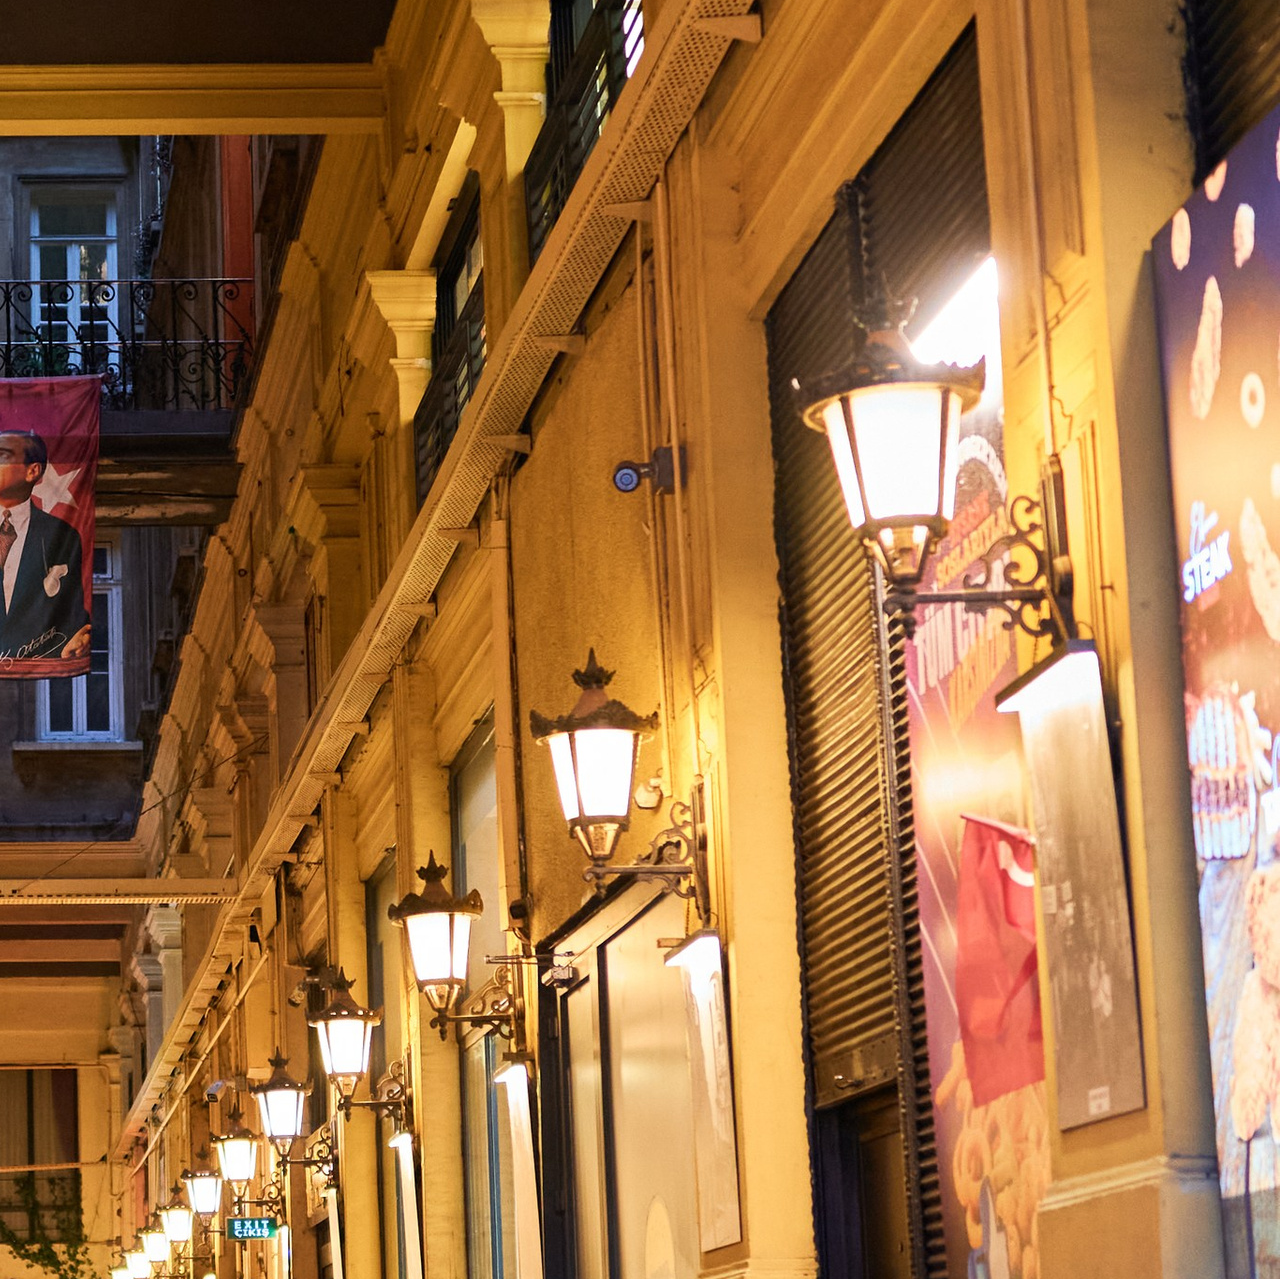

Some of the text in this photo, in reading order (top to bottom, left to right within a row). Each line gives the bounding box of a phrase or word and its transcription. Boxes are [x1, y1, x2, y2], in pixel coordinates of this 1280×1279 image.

[1182, 529, 1233, 604] STEAK
[233, 1220, 269, 1230] EXIT
[234, 1228, 270, 1239] ÇIKIŞ
